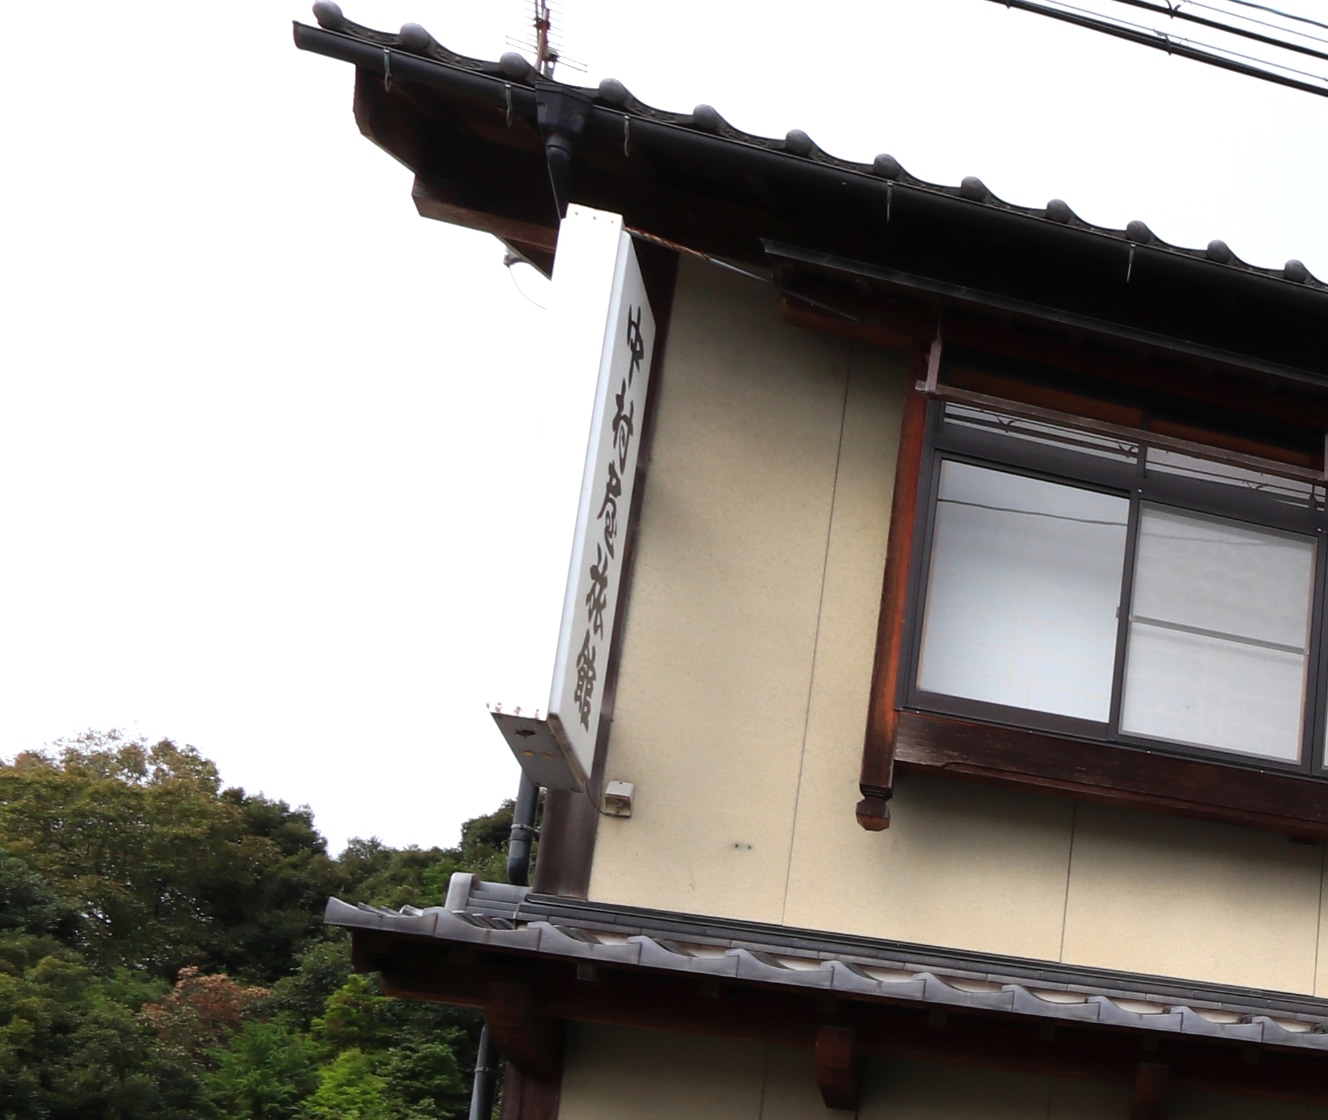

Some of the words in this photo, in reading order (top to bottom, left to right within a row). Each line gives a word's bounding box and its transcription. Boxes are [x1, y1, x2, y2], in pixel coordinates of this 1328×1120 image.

[574, 304, 645, 733] 中村屋旅館
